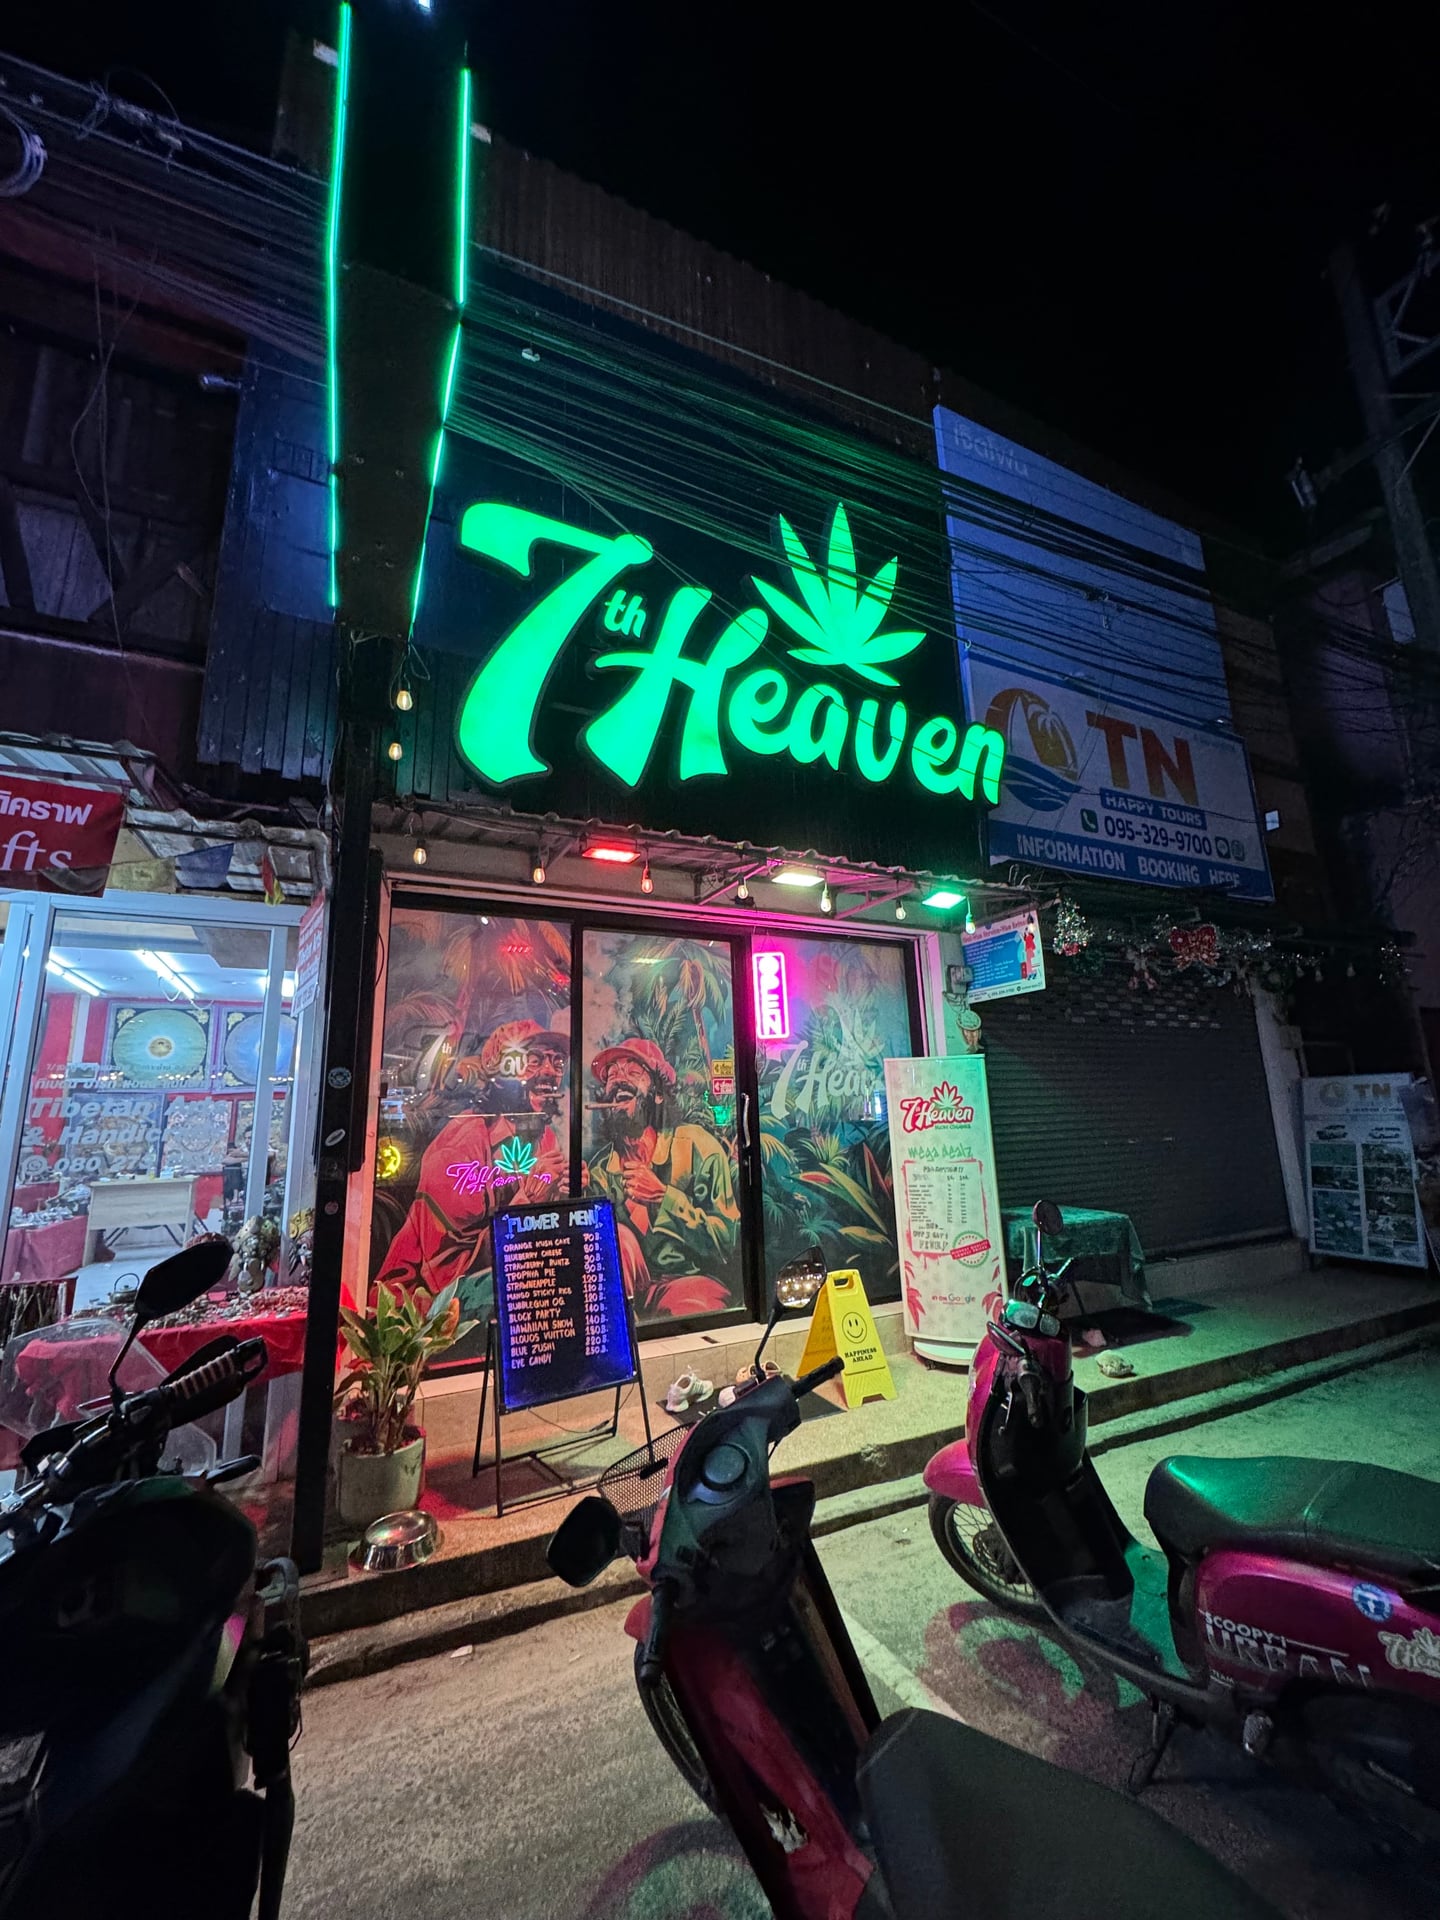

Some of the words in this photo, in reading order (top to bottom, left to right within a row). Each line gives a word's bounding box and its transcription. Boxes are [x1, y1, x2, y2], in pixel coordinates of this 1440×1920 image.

[460, 503, 653, 783] 7th
[585, 587, 1005, 805] Heaven
[1086, 710, 1199, 805] TN
[1105, 795, 1154, 815] HAPPY
[1160, 806, 1202, 827] TOURS
[1104, 816, 1213, 856] 095-329-9700
[1017, 833, 1126, 872] INFORMATION
[1138, 856, 1200, 884] BOOKING
[758, 955, 783, 1036] OPEN
[1353, 1083, 1391, 1098] TN
[31, 1095, 153, 1118] Tibetan
[915, 1103, 973, 1130] Heaven
[54, 1156, 101, 1173] 080
[508, 1212, 560, 1233] FLOWER
[569, 1208, 599, 1228] MENU
[503, 1242, 533, 1252] ORANGE
[544, 1267, 556, 1277] PIE
[509, 1311, 532, 1324] BLOCK
[535, 1307, 561, 1320] PARTY
[510, 1320, 549, 1336] HAWAIIAN
[552, 1317, 574, 1330] SNOW
[543, 1327, 576, 1341] VUITTON
[511, 1345, 528, 1358] BLUE
[531, 1341, 556, 1355] ZUSHI
[844, 1347, 878, 1359] HAPPINESS
[511, 1357, 526, 1369] EYE
[528, 1352, 552, 1367] CANDY
[852, 1354, 874, 1364] AHEAD
